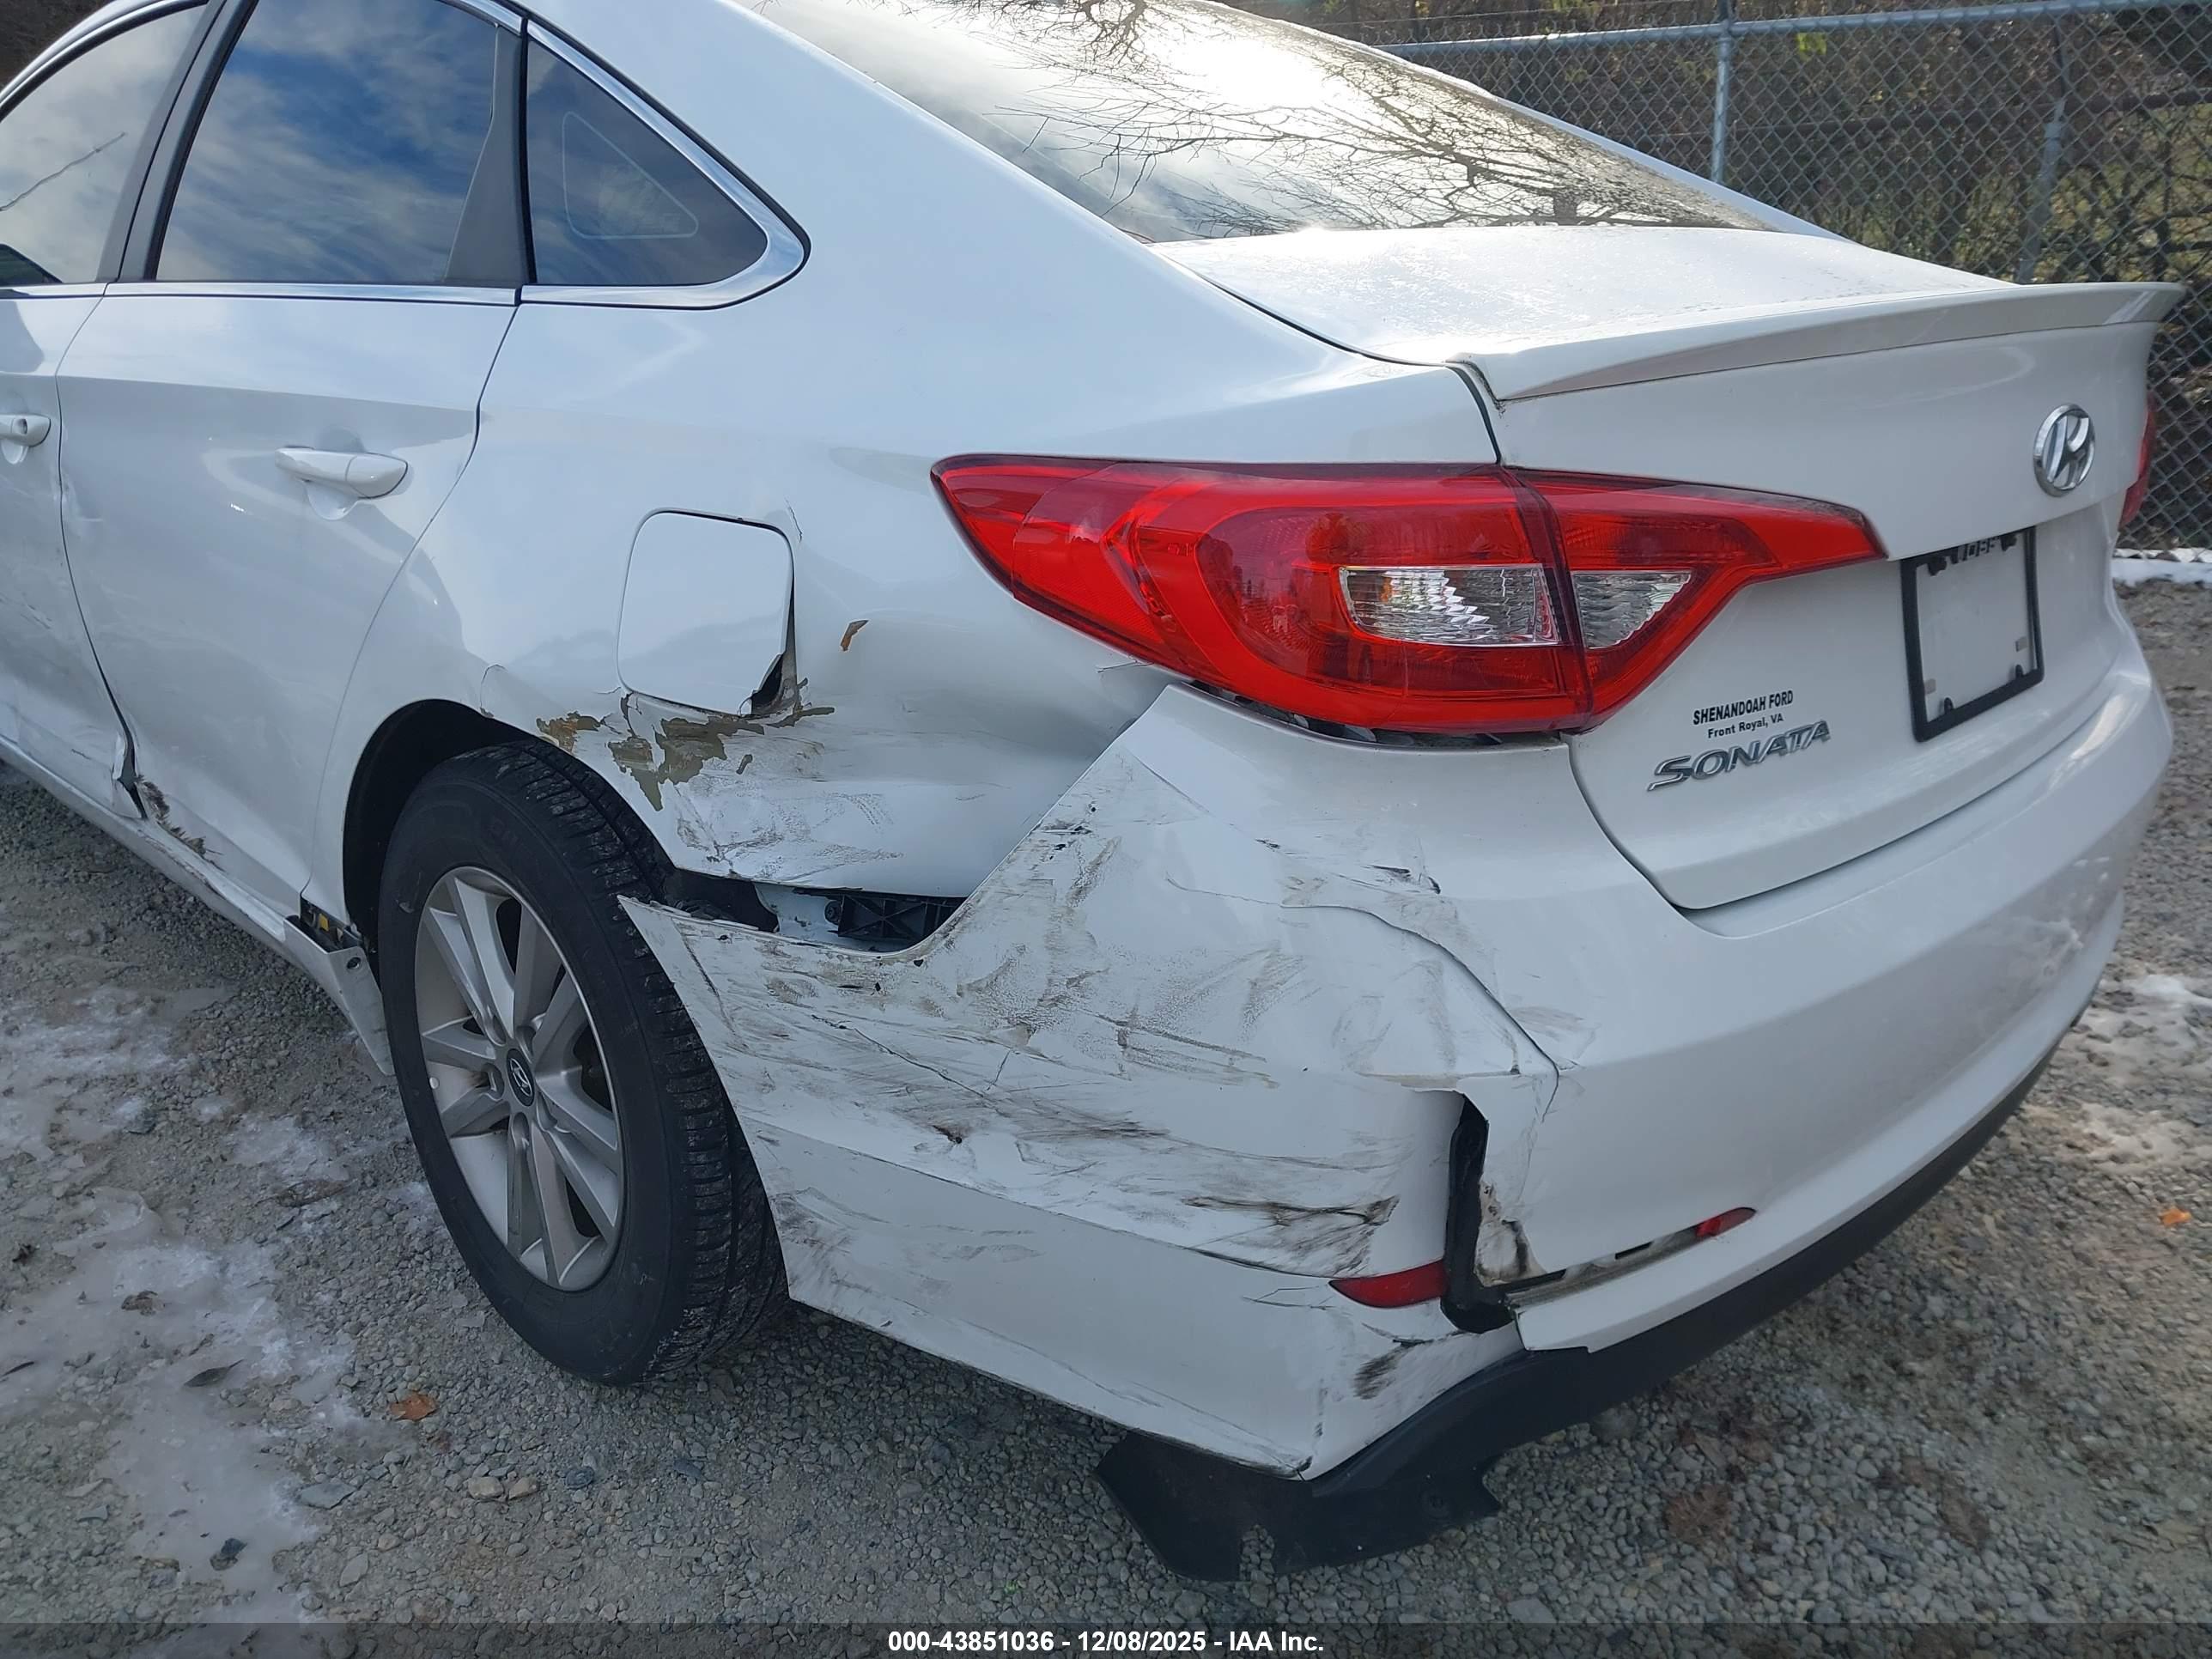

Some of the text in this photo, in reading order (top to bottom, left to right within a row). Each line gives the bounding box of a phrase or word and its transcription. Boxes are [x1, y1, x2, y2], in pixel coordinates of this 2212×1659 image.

[1692, 690, 1794, 726] SHENANDOAH FORD
[1708, 713, 1784, 738] Front Royal, VA
[1647, 720, 1831, 792] SONATA
